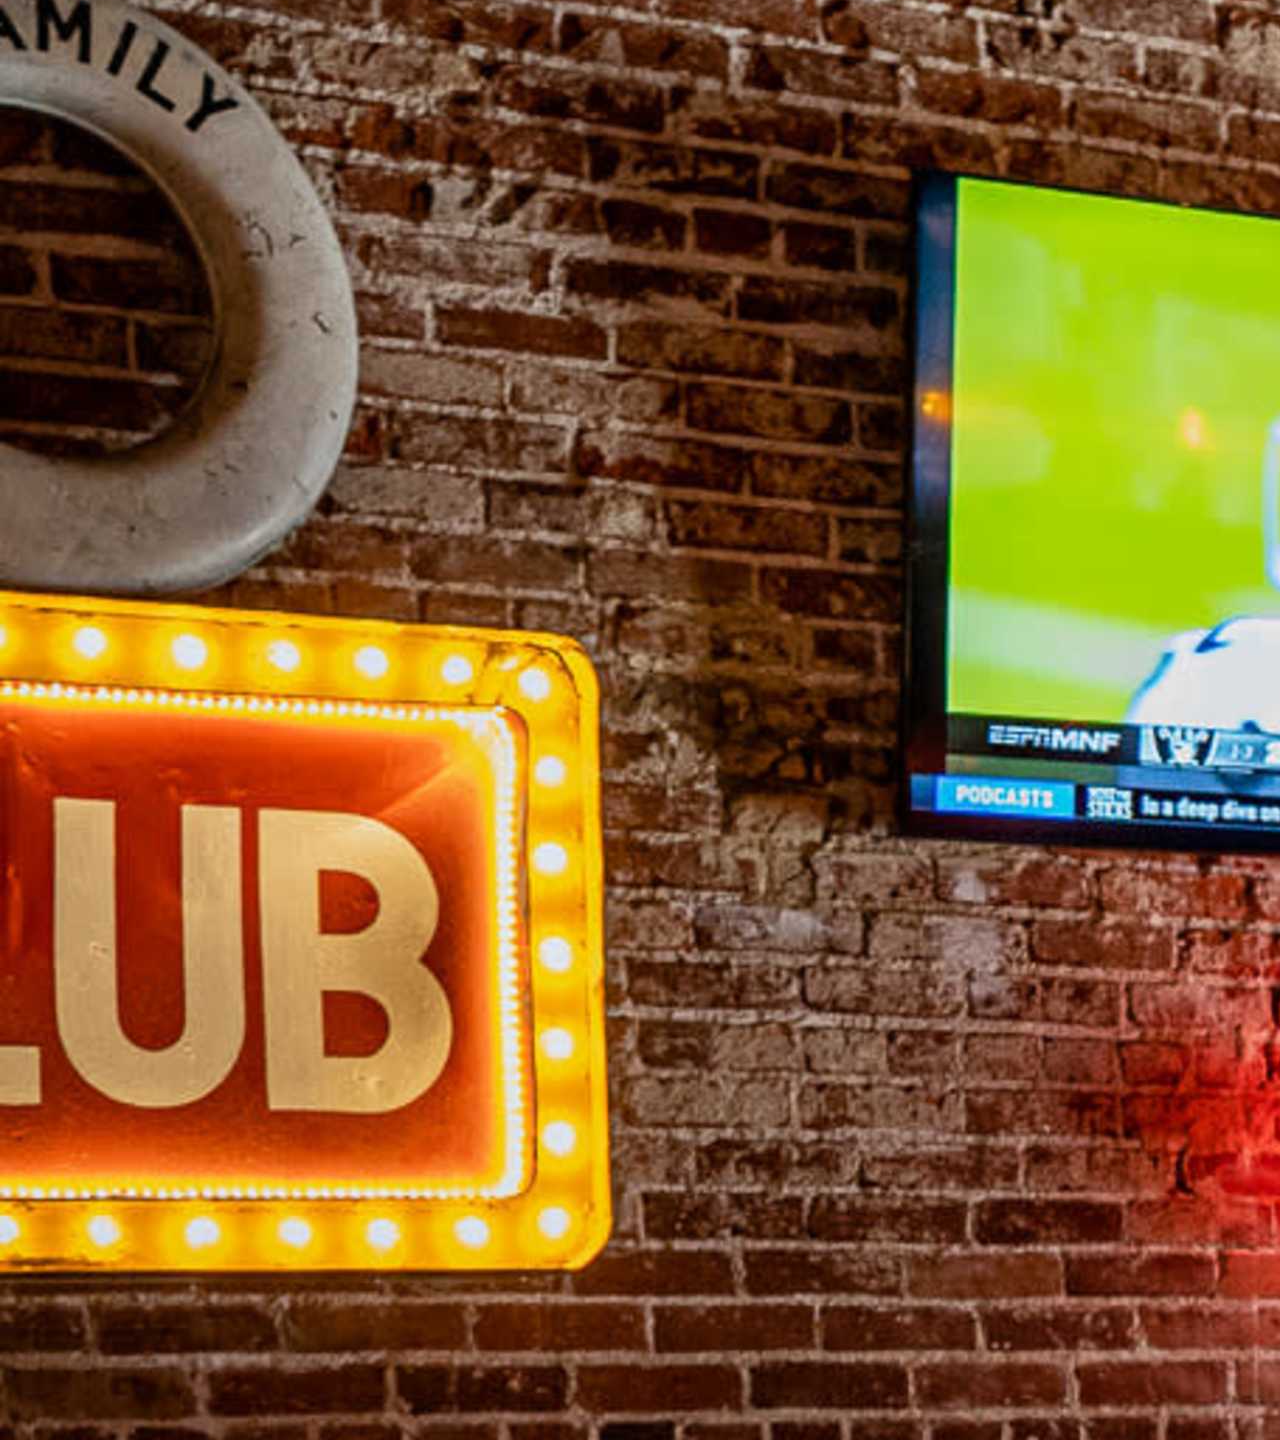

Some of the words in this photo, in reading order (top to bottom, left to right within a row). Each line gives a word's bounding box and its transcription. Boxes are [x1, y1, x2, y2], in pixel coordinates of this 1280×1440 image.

[956, 785, 1053, 808] PODCASTS
[1177, 798, 1218, 821] deep
[1221, 800, 1258, 820] dive
[1260, 805, 1280, 821] on
